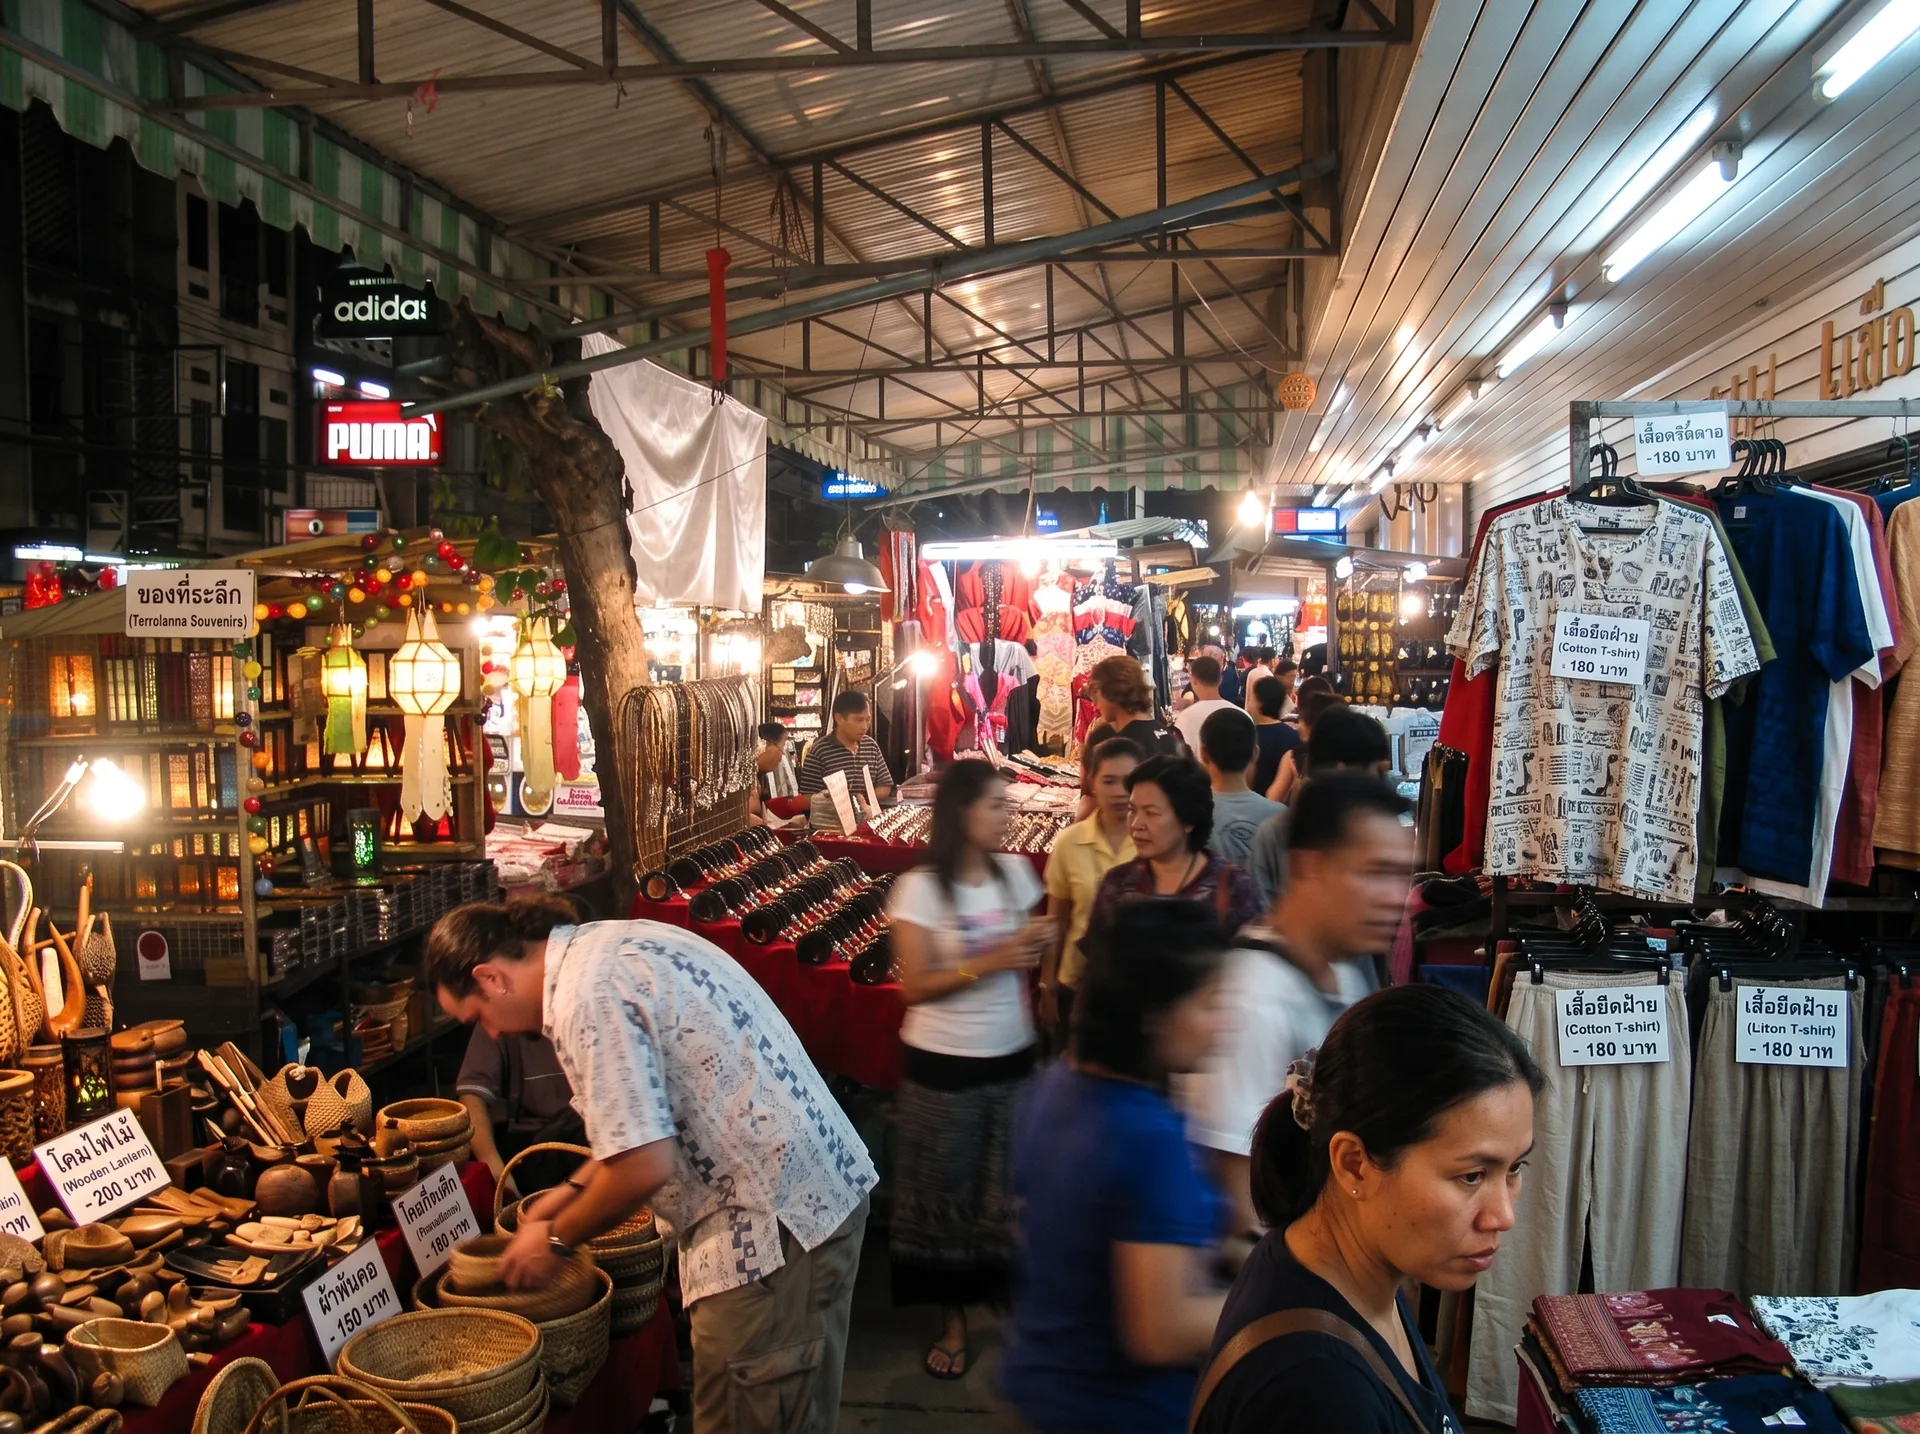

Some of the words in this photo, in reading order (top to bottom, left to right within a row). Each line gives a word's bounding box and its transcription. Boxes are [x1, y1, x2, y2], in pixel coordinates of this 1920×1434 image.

[328, 422, 430, 460] PUMA
[1686, 448, 1716, 461] บาท
[137, 573, 242, 604] ของที่ระลึก
[190, 614, 248, 630] Souvenirs)
[1558, 641, 1597, 656] (Cotton
[1601, 645, 1640, 661] T-shirt)
[1570, 660, 1595, 673] 180
[1600, 664, 1628, 677] บาท
[1565, 1023, 1612, 1038] (Cotton
[1615, 1020, 1661, 1034] T-shirt)
[1790, 1023, 1836, 1039] T-shirt)
[1586, 1042, 1616, 1057] 180
[1622, 1042, 1657, 1056] บาท
[1762, 1042, 1793, 1057] 180
[1799, 1045, 1833, 1060] บาท
[62, 1164, 110, 1196] (Wooden
[92, 1181, 123, 1207] 200
[123, 1166, 157, 1191] บาท
[430, 1232, 450, 1257] 180
[449, 1218, 471, 1242] บาท
[318, 1261, 378, 1316] ผ้าพันคอ
[337, 1307, 362, 1338] 150
[362, 1287, 391, 1318] บาท
